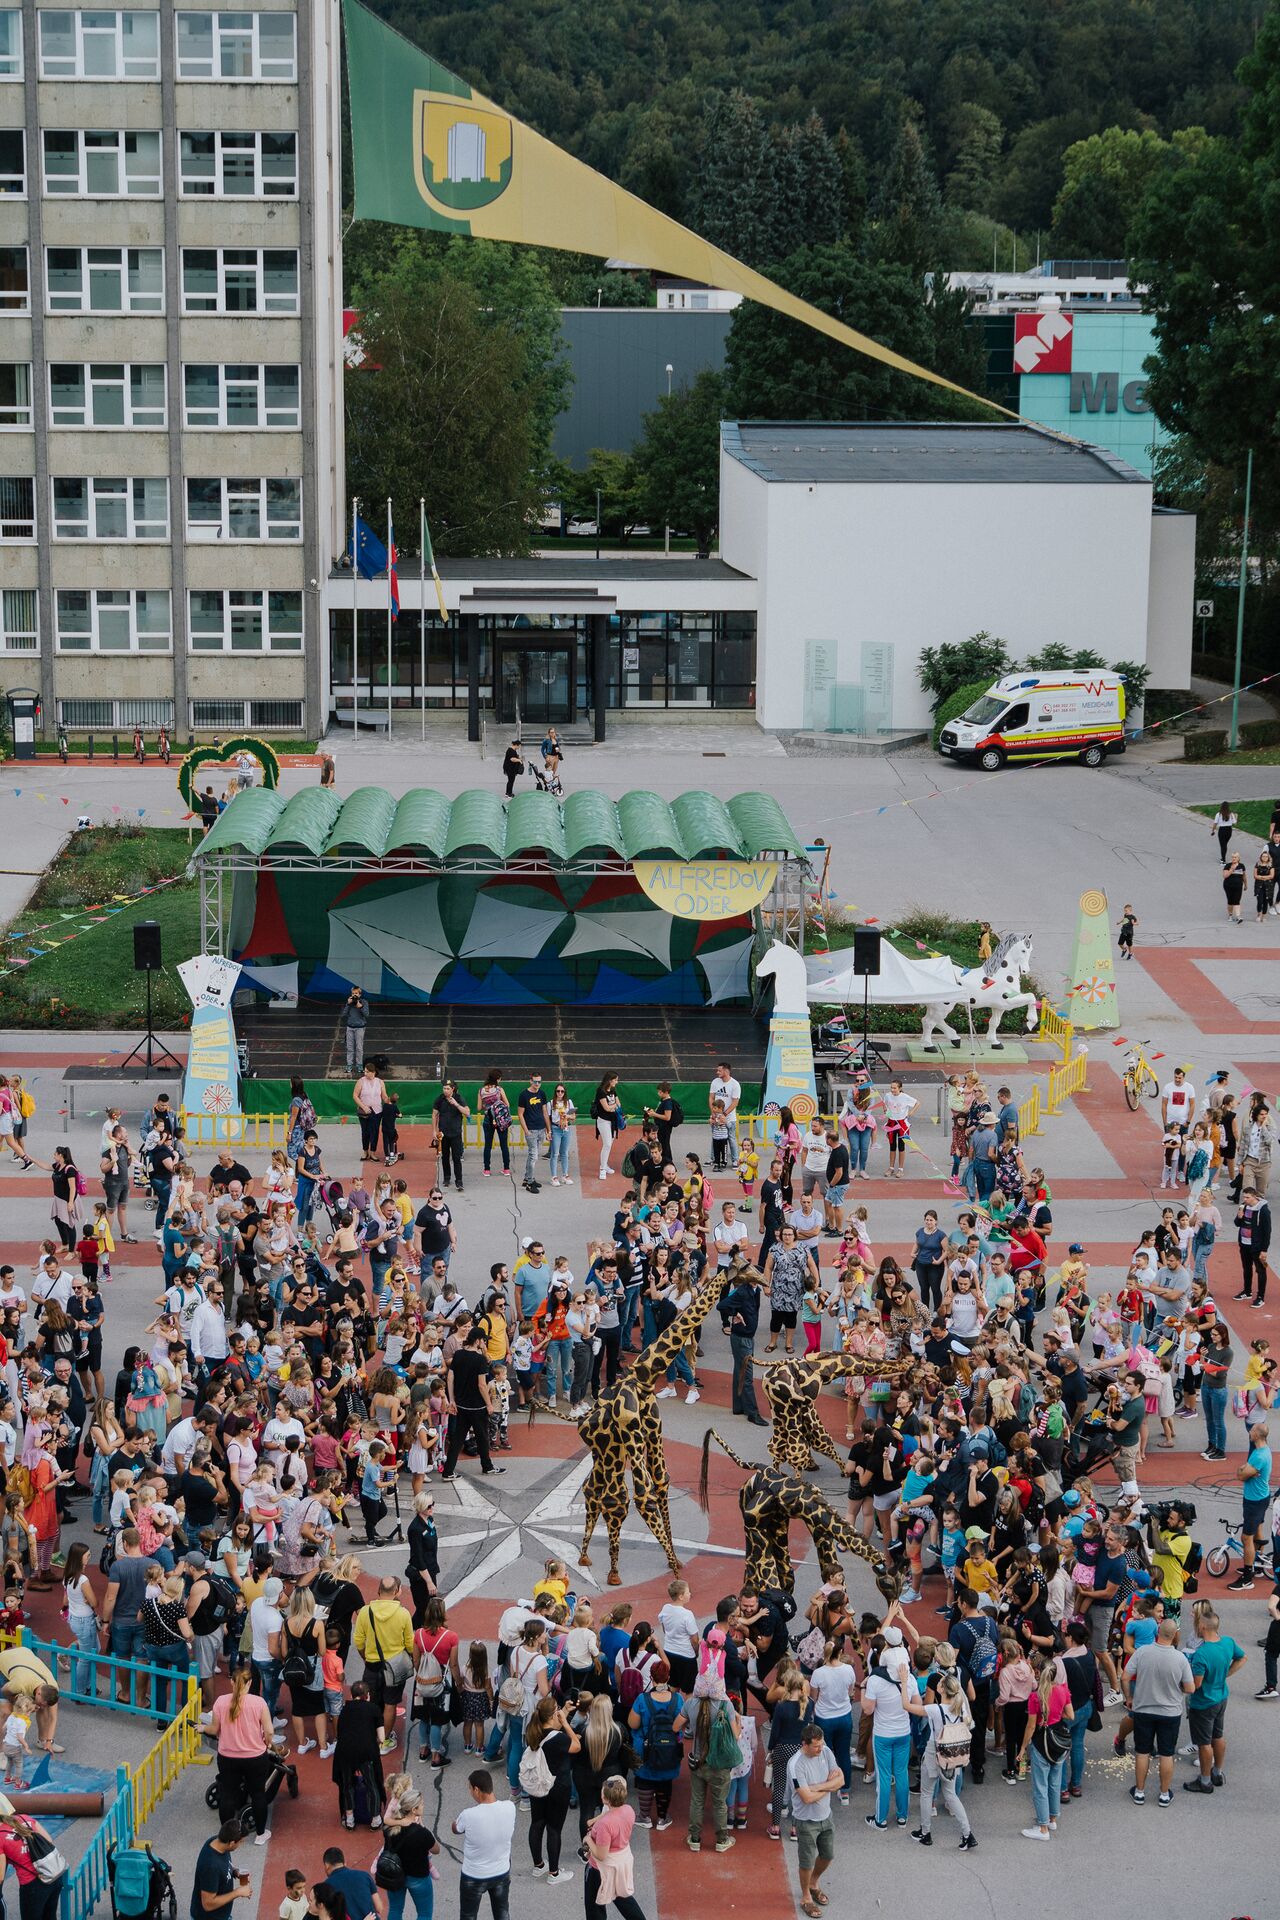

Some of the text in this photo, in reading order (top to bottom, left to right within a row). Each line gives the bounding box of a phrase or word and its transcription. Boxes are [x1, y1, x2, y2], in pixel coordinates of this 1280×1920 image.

[674, 893, 738, 915] ODER
[212, 957, 241, 972] ALFREDOV
[1098, 960, 1109, 969] WC
[201, 994, 218, 1005] ODER
